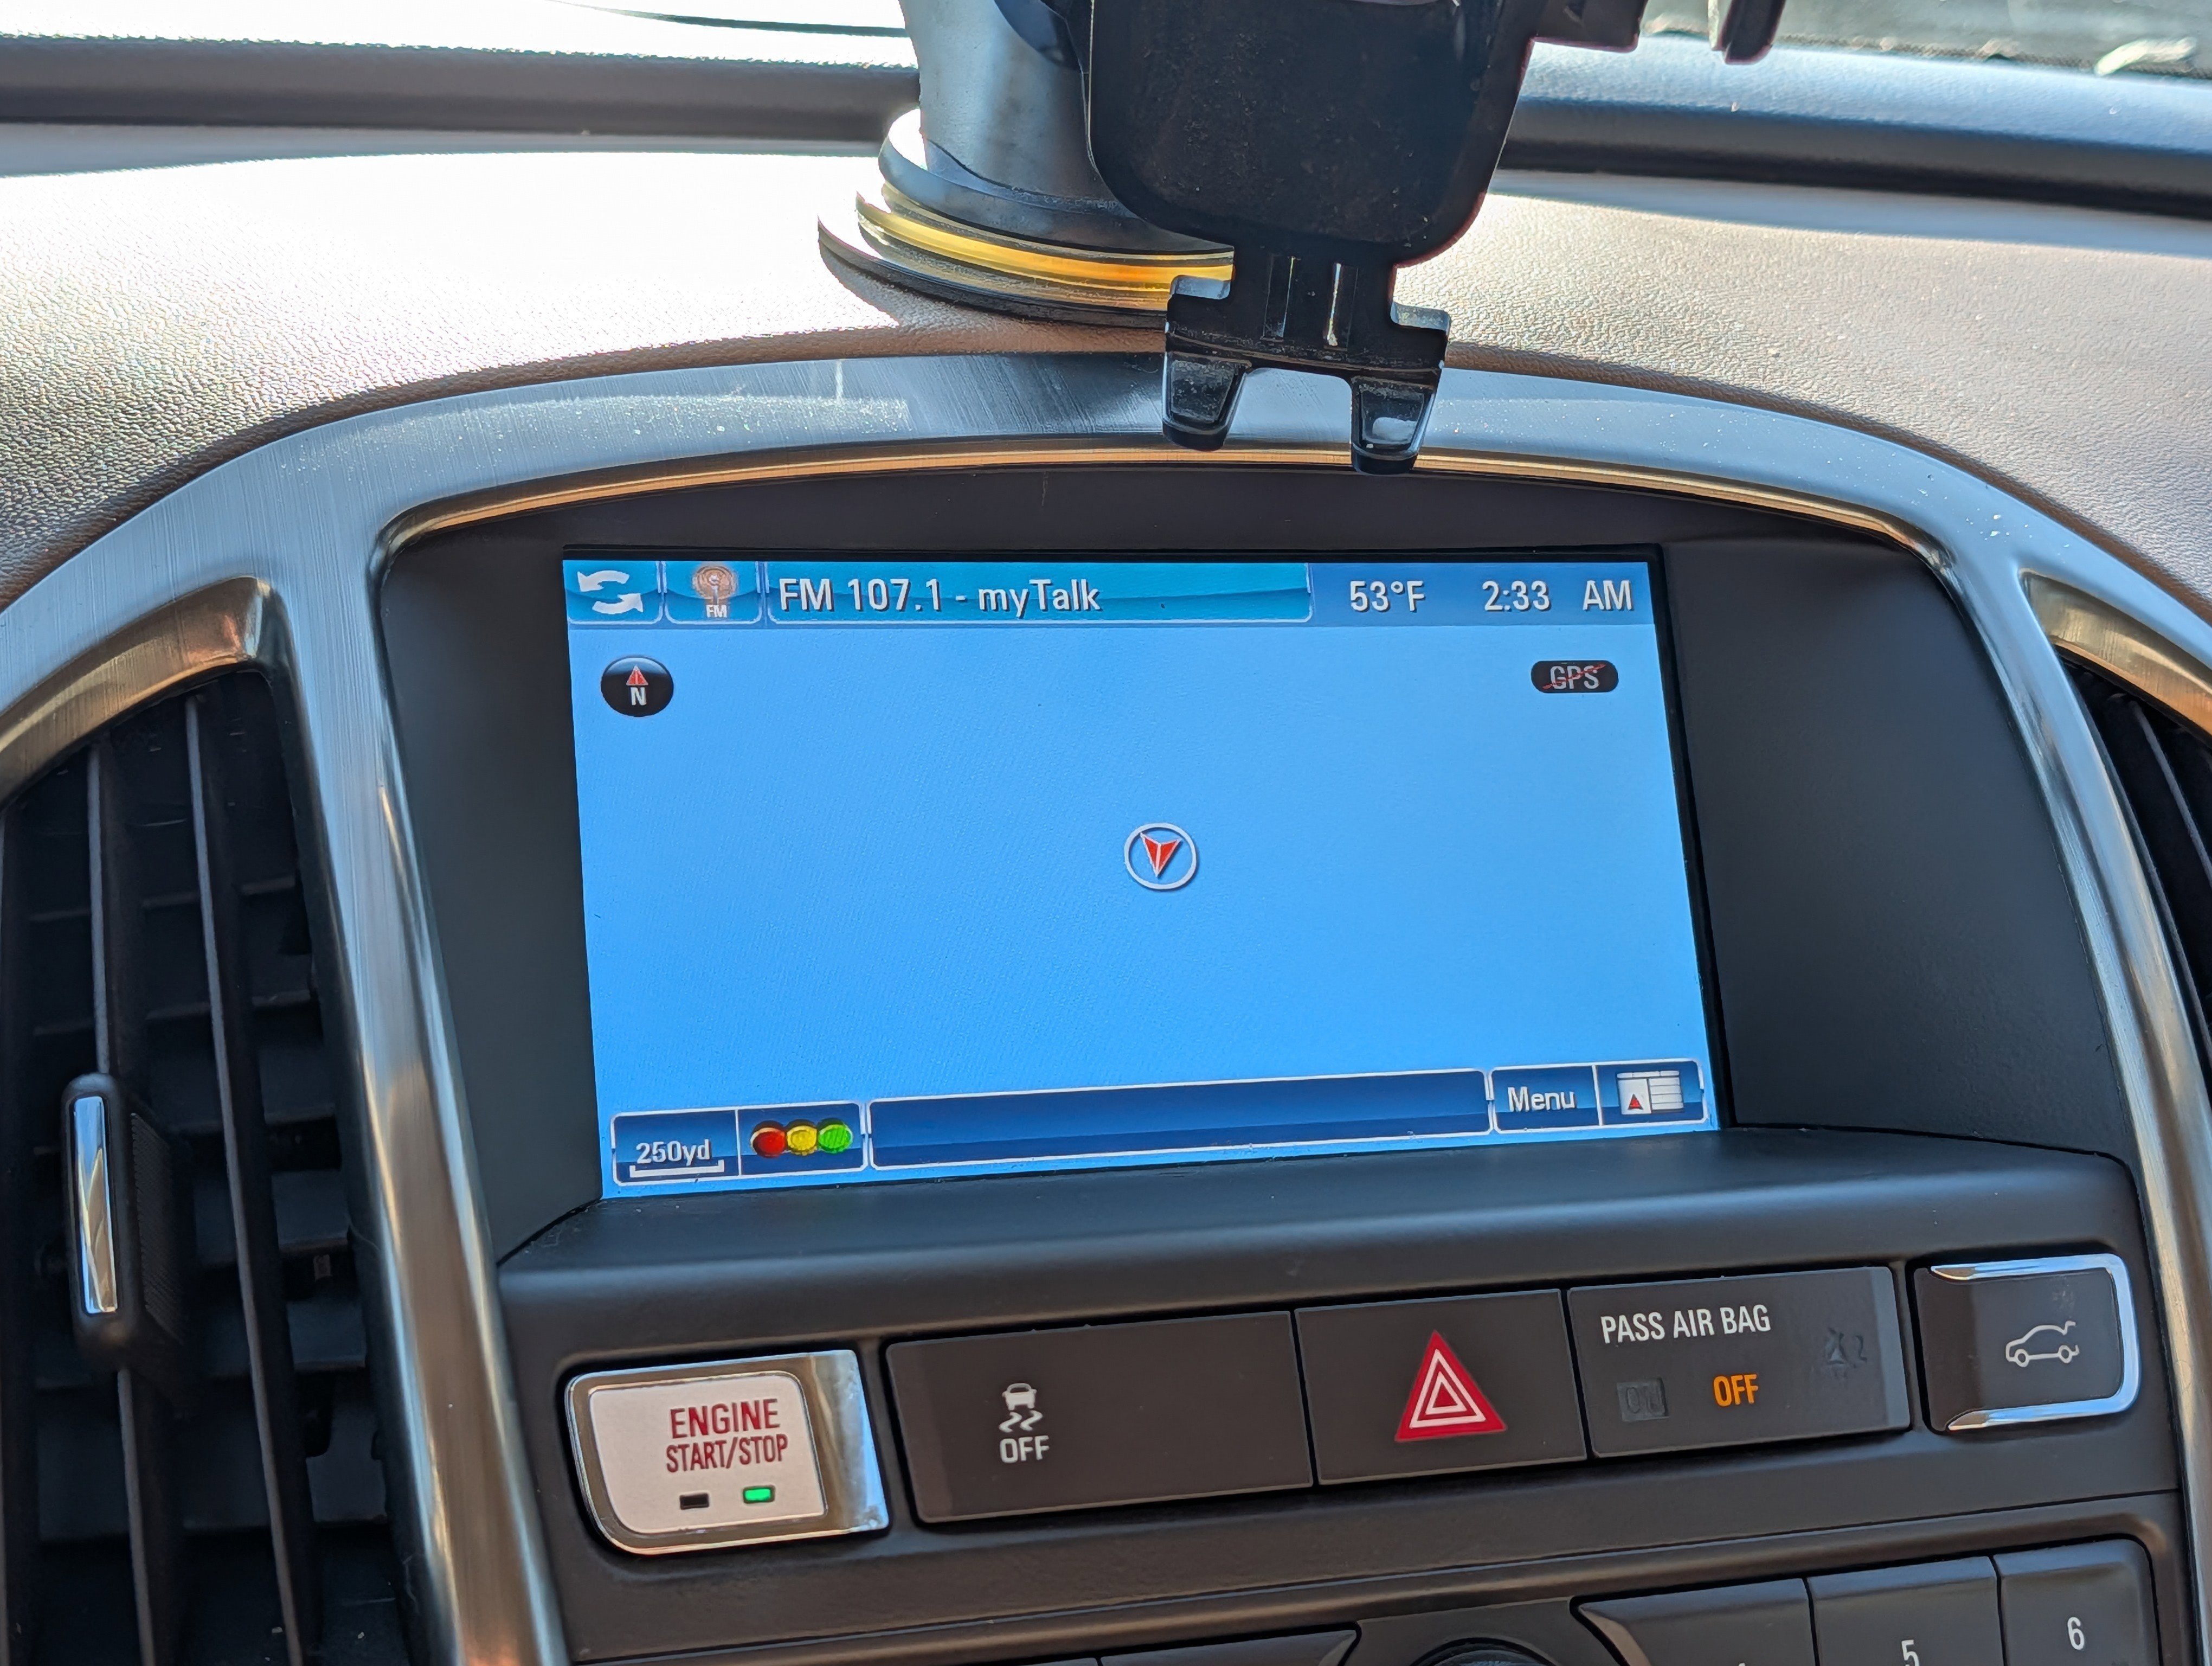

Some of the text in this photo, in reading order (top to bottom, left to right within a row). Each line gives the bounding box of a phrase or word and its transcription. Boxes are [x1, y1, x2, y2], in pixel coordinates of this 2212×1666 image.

[706, 604, 728, 618] FM
[780, 578, 832, 612] FM
[852, 578, 943, 612] 107.1
[978, 579, 1101, 619] myTalk
[1350, 580, 1633, 612] 53°F 2:33 AM
[1549, 665, 1600, 690] GPS
[629, 687, 646, 706] N
[1507, 1086, 1576, 1112] Menu
[635, 1139, 711, 1166] 250yd
[1600, 1304, 1771, 1344] PASS AIR BAG
[1713, 1374, 1759, 1407] OFF
[670, 1399, 780, 1438] ENGINE
[666, 1434, 788, 1473] START/STOP
[999, 1435, 1050, 1464] OFF
[2067, 1617, 2085, 1650] 6
[1901, 1639, 1920, 1666] 5
